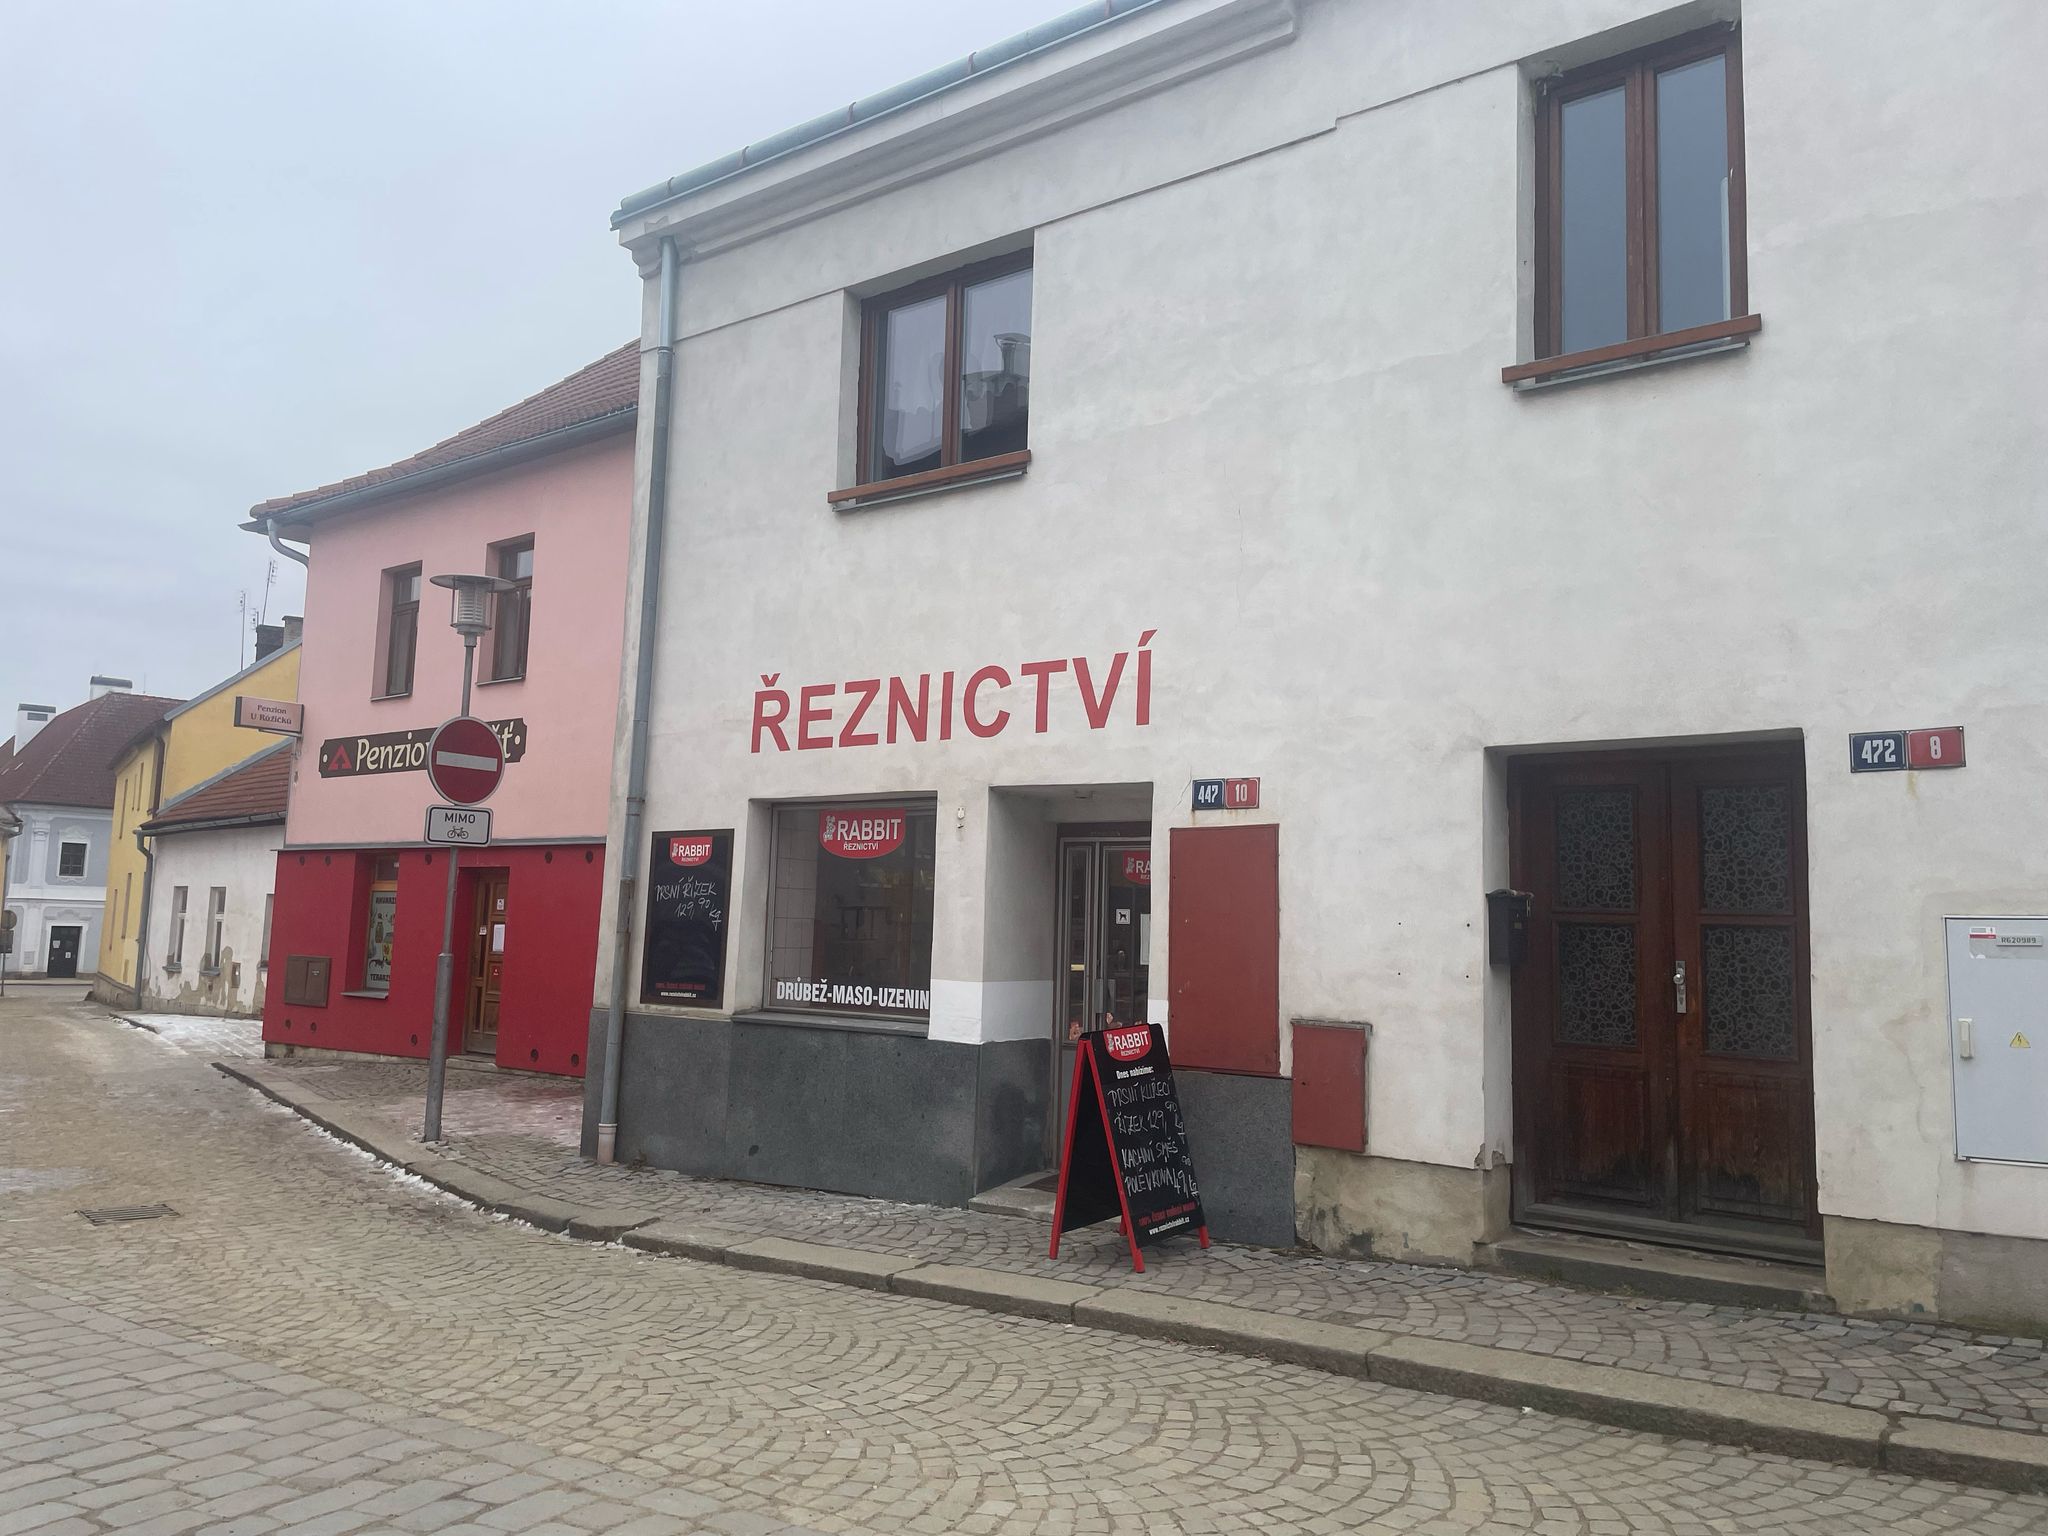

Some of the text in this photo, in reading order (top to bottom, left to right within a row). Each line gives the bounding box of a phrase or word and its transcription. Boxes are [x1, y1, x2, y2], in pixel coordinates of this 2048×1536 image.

[750, 628, 1158, 754] ŘEZNICTVÍ
[257, 704, 287, 714] Penzion
[250, 712, 257, 720] U
[1861, 735, 1942, 764] 472 8
[1197, 783, 1248, 804] 447 10
[444, 812, 476, 824] MIMO
[837, 818, 902, 841] RABBIT
[678, 844, 711, 857] RABBIT
[843, 841, 879, 851] ŘEZNICTVÍ
[1113, 1031, 1149, 1051] RABBIT
[1116, 1070, 1129, 1080] Dnes
